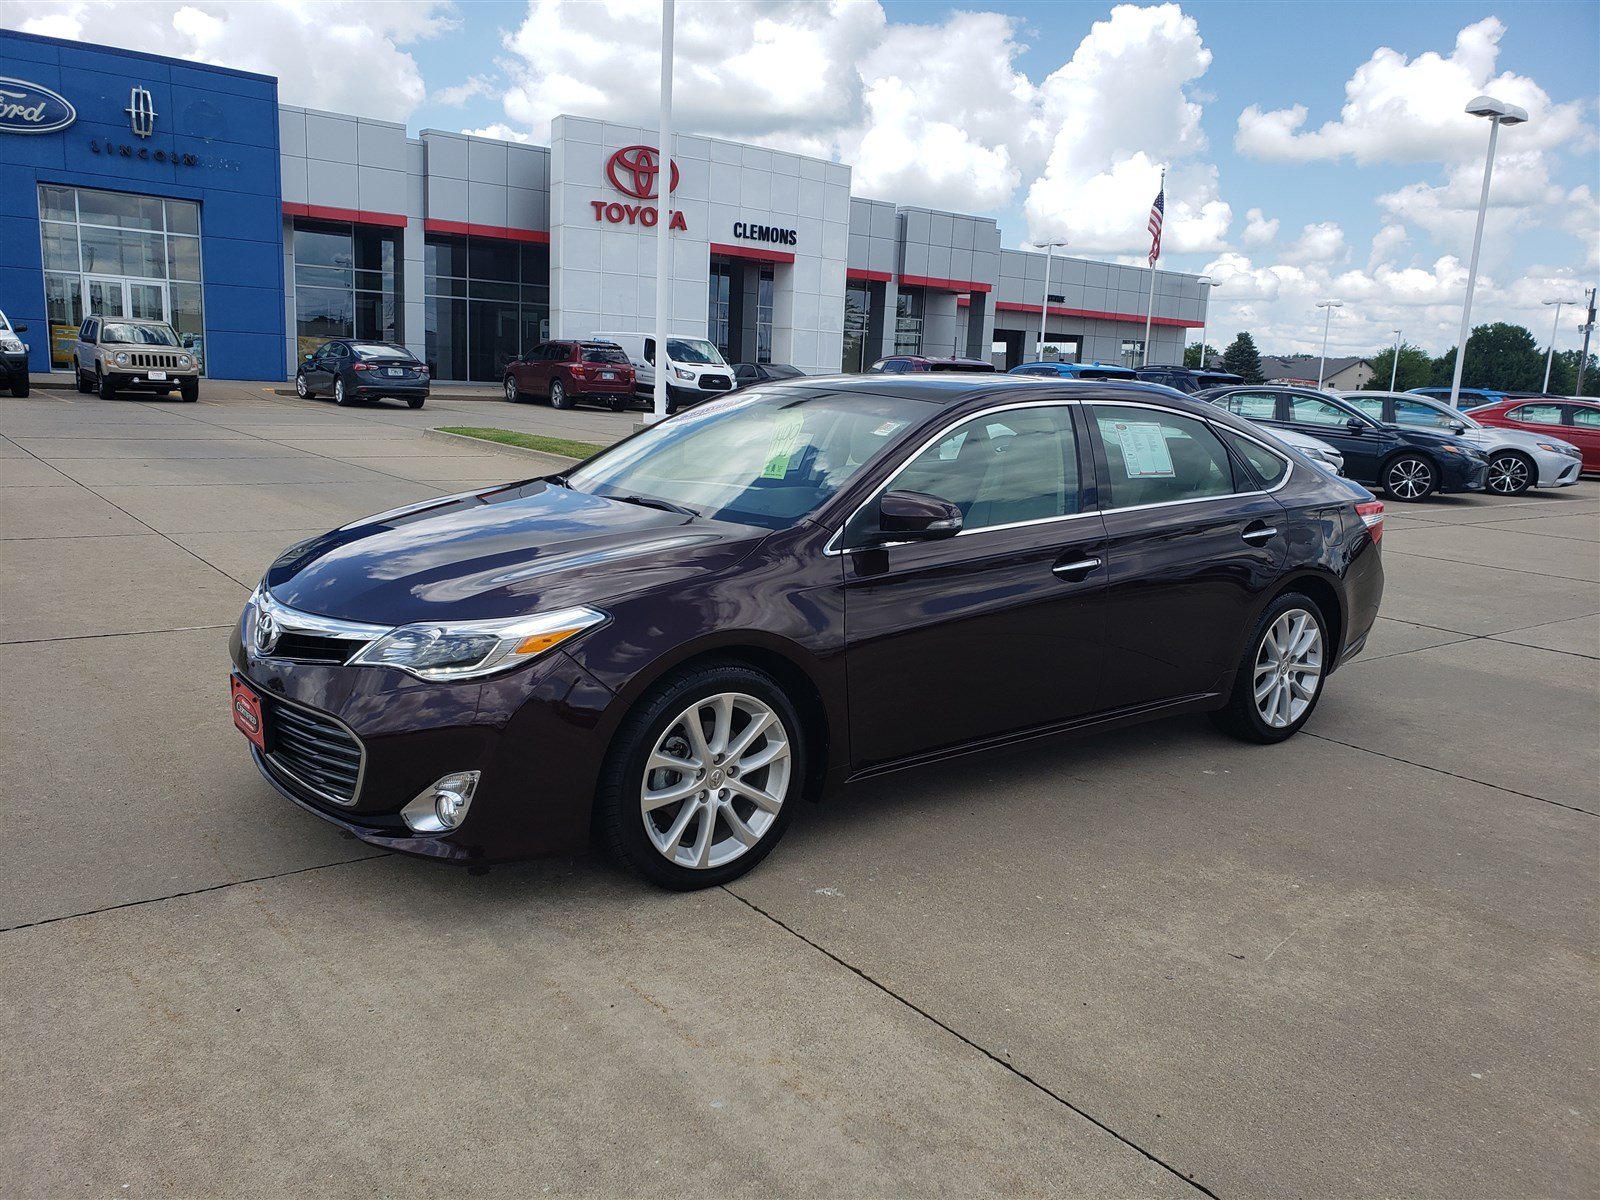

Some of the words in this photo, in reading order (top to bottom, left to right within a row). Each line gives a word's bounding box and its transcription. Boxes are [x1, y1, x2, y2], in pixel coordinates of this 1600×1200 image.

[90, 139, 198, 167] LINCOLN
[591, 201, 687, 231] TOYOA
[733, 222, 797, 246] CLEMONS
